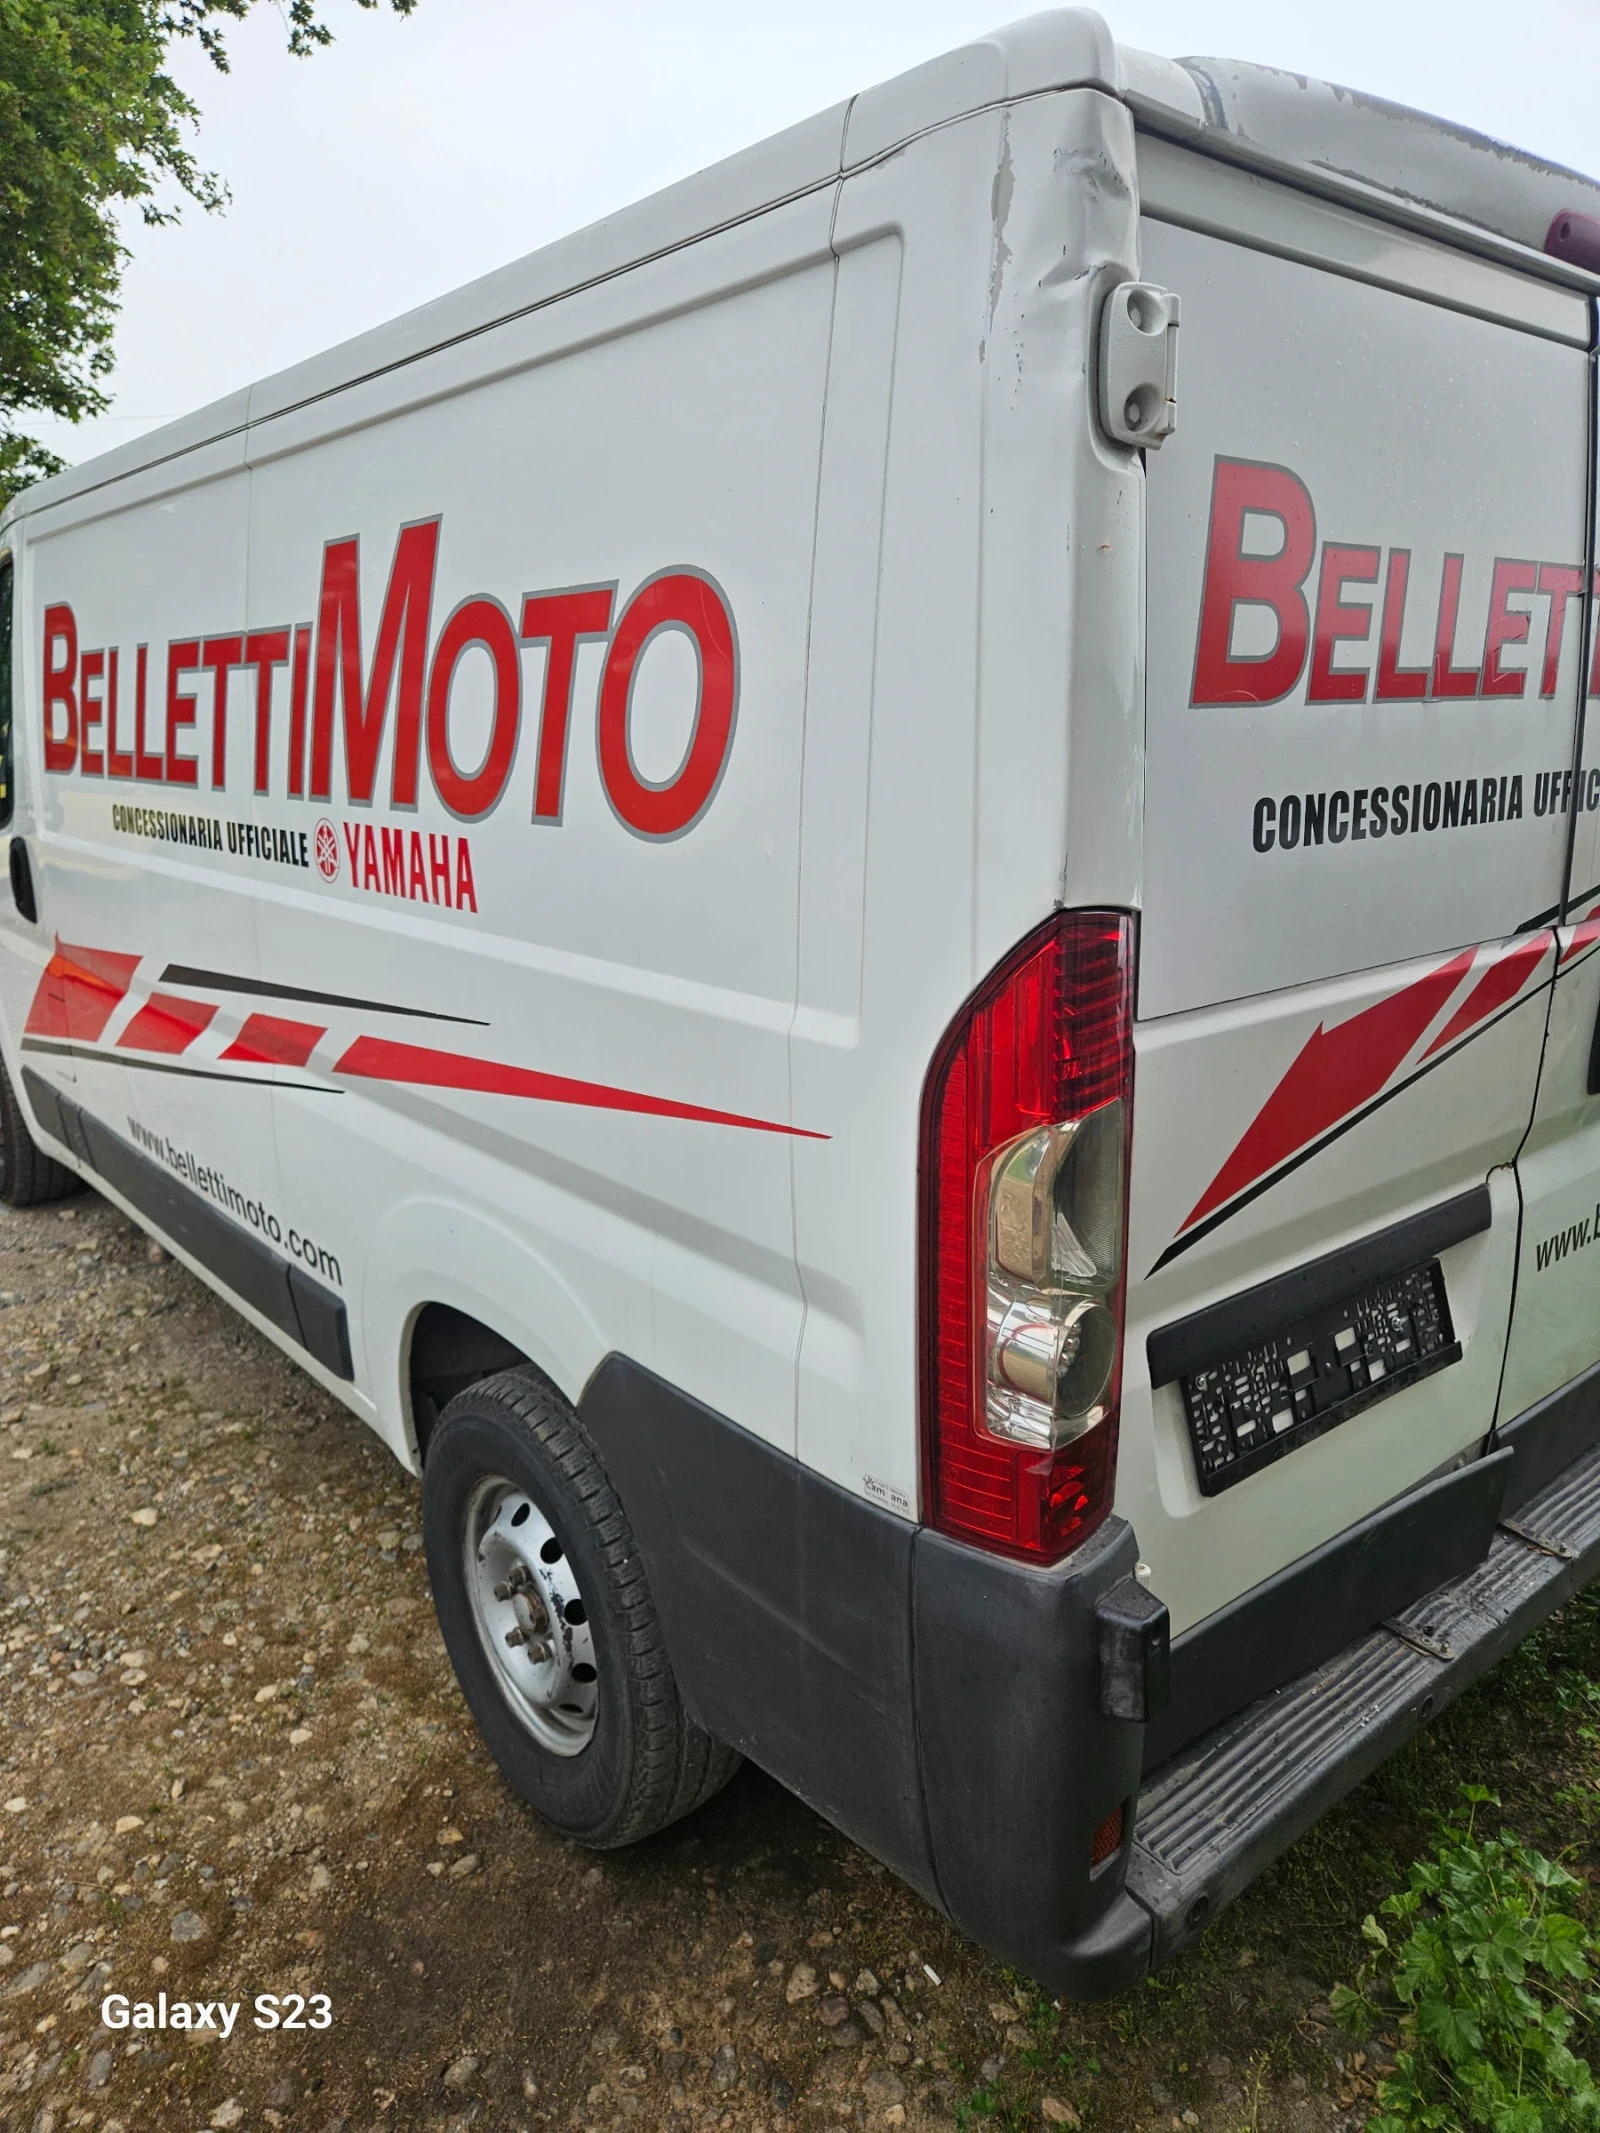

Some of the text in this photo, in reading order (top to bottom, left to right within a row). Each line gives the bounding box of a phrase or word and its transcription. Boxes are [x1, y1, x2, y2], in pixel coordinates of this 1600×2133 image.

[1188, 453, 1600, 710] BELLET
[112, 803, 309, 868] CONCESSIONARIA UFFICIALE
[1252, 768, 1600, 853] CONCESSIONARIA UFFIC
[343, 821, 478, 914] YAMAHA
[126, 1115, 343, 1287] www.bellettimoto.com
